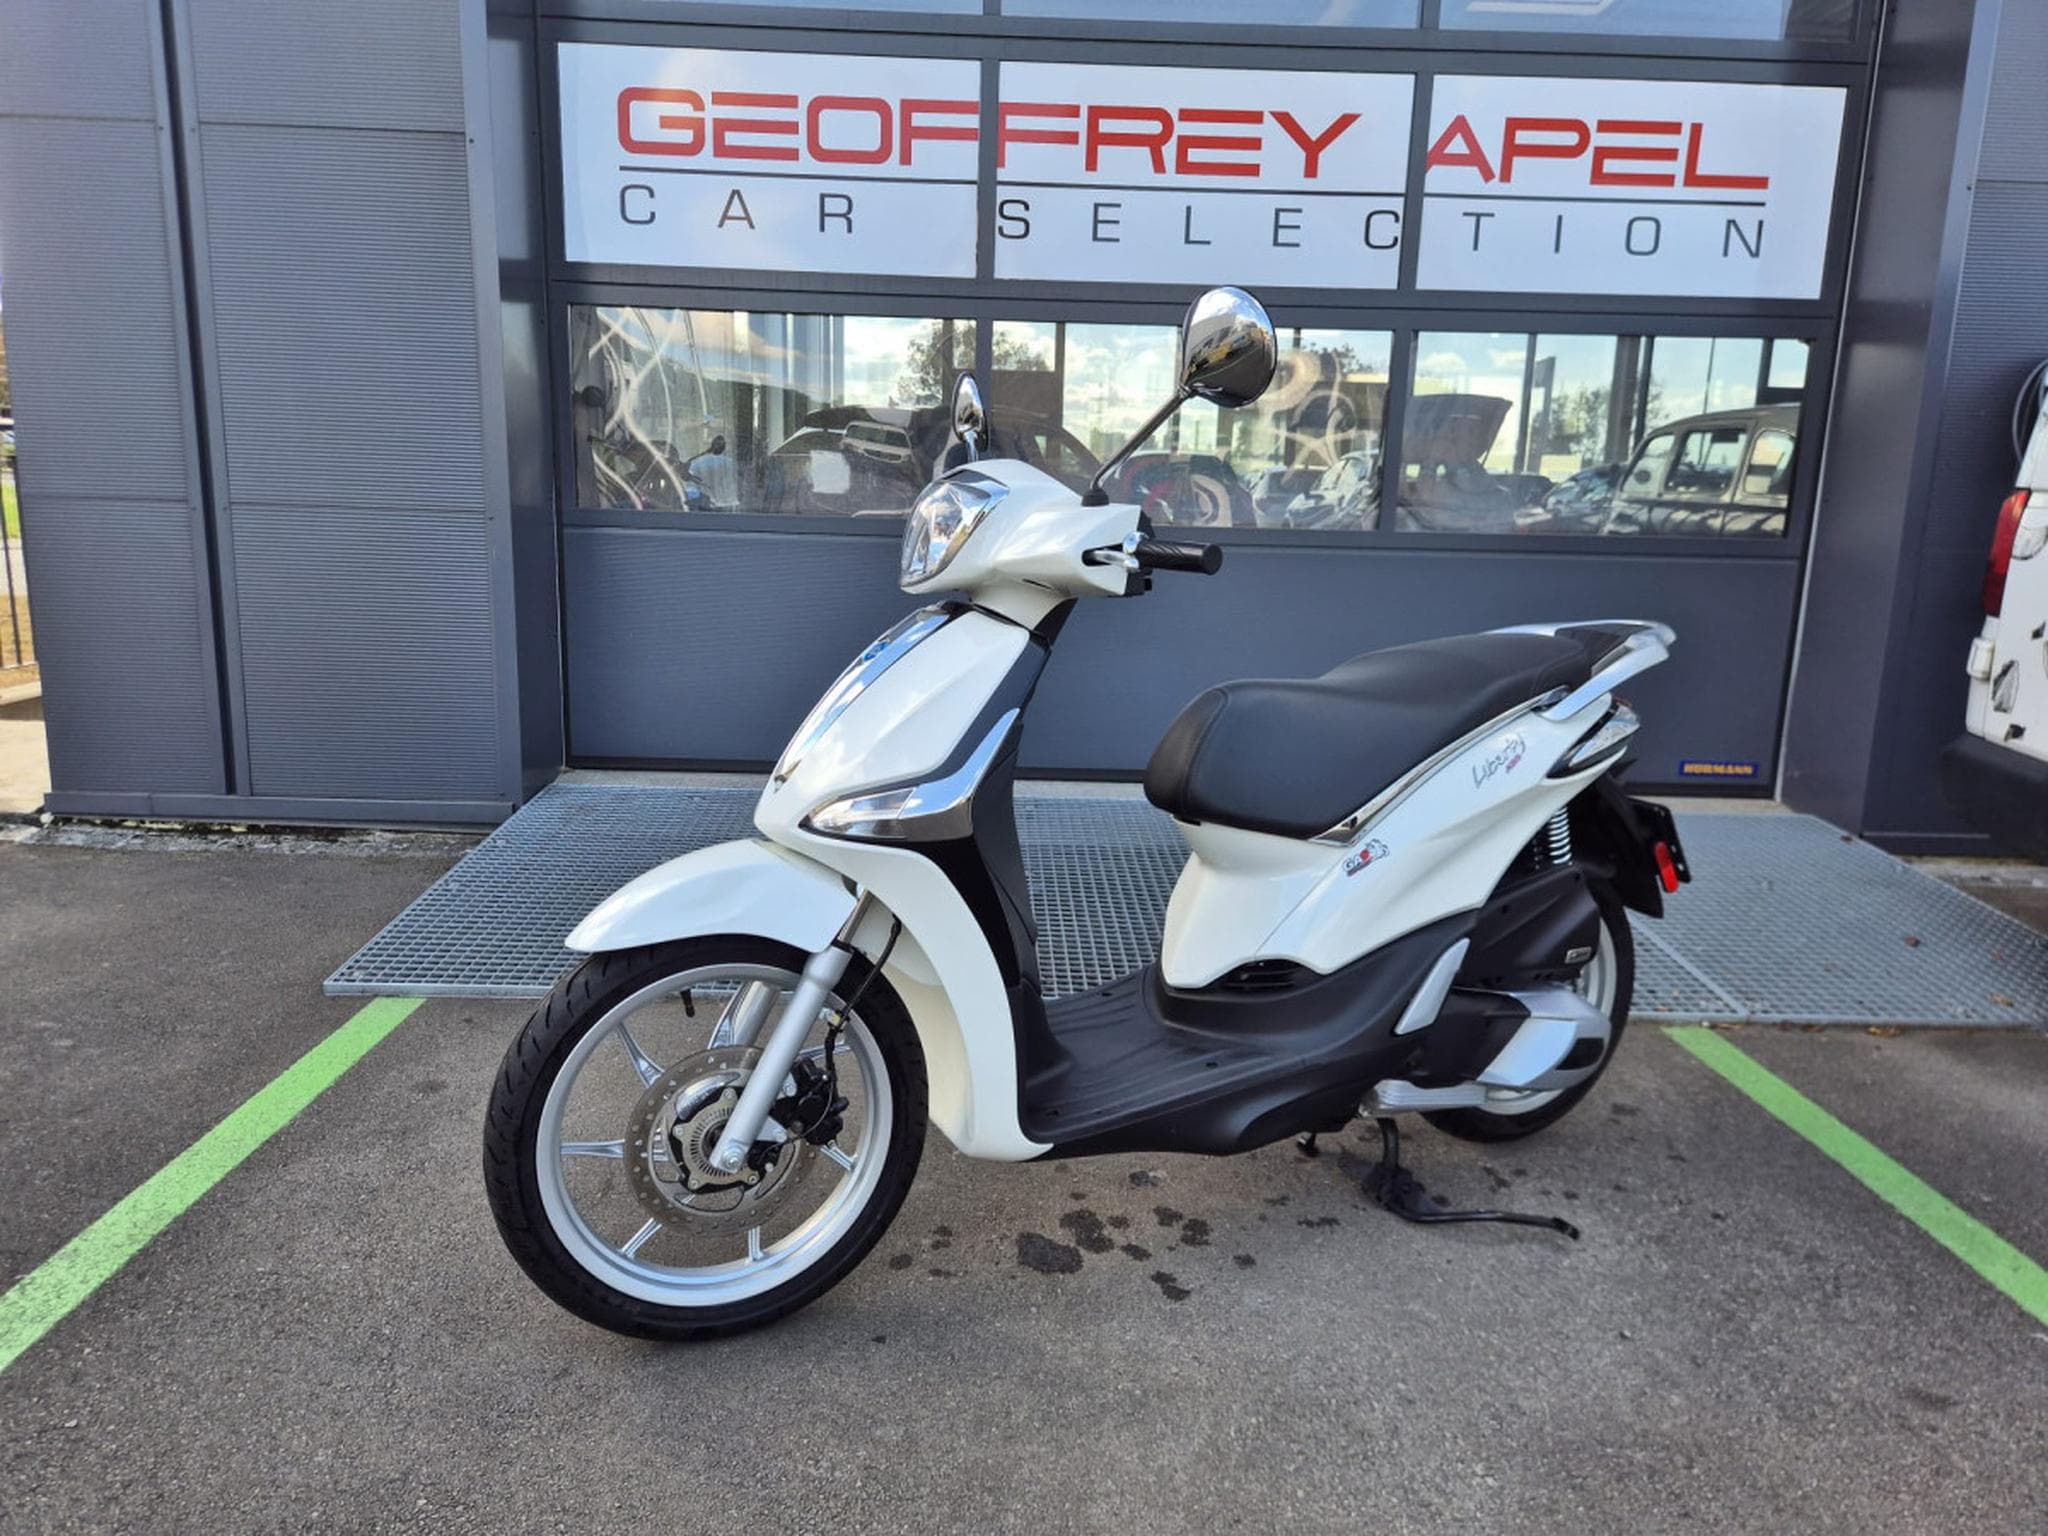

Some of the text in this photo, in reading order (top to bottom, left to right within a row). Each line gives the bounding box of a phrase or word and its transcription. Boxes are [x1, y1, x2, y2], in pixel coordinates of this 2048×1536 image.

[617, 86, 1769, 190] GEOFFREY APEL
[619, 184, 1765, 259] CAR SELECTION
